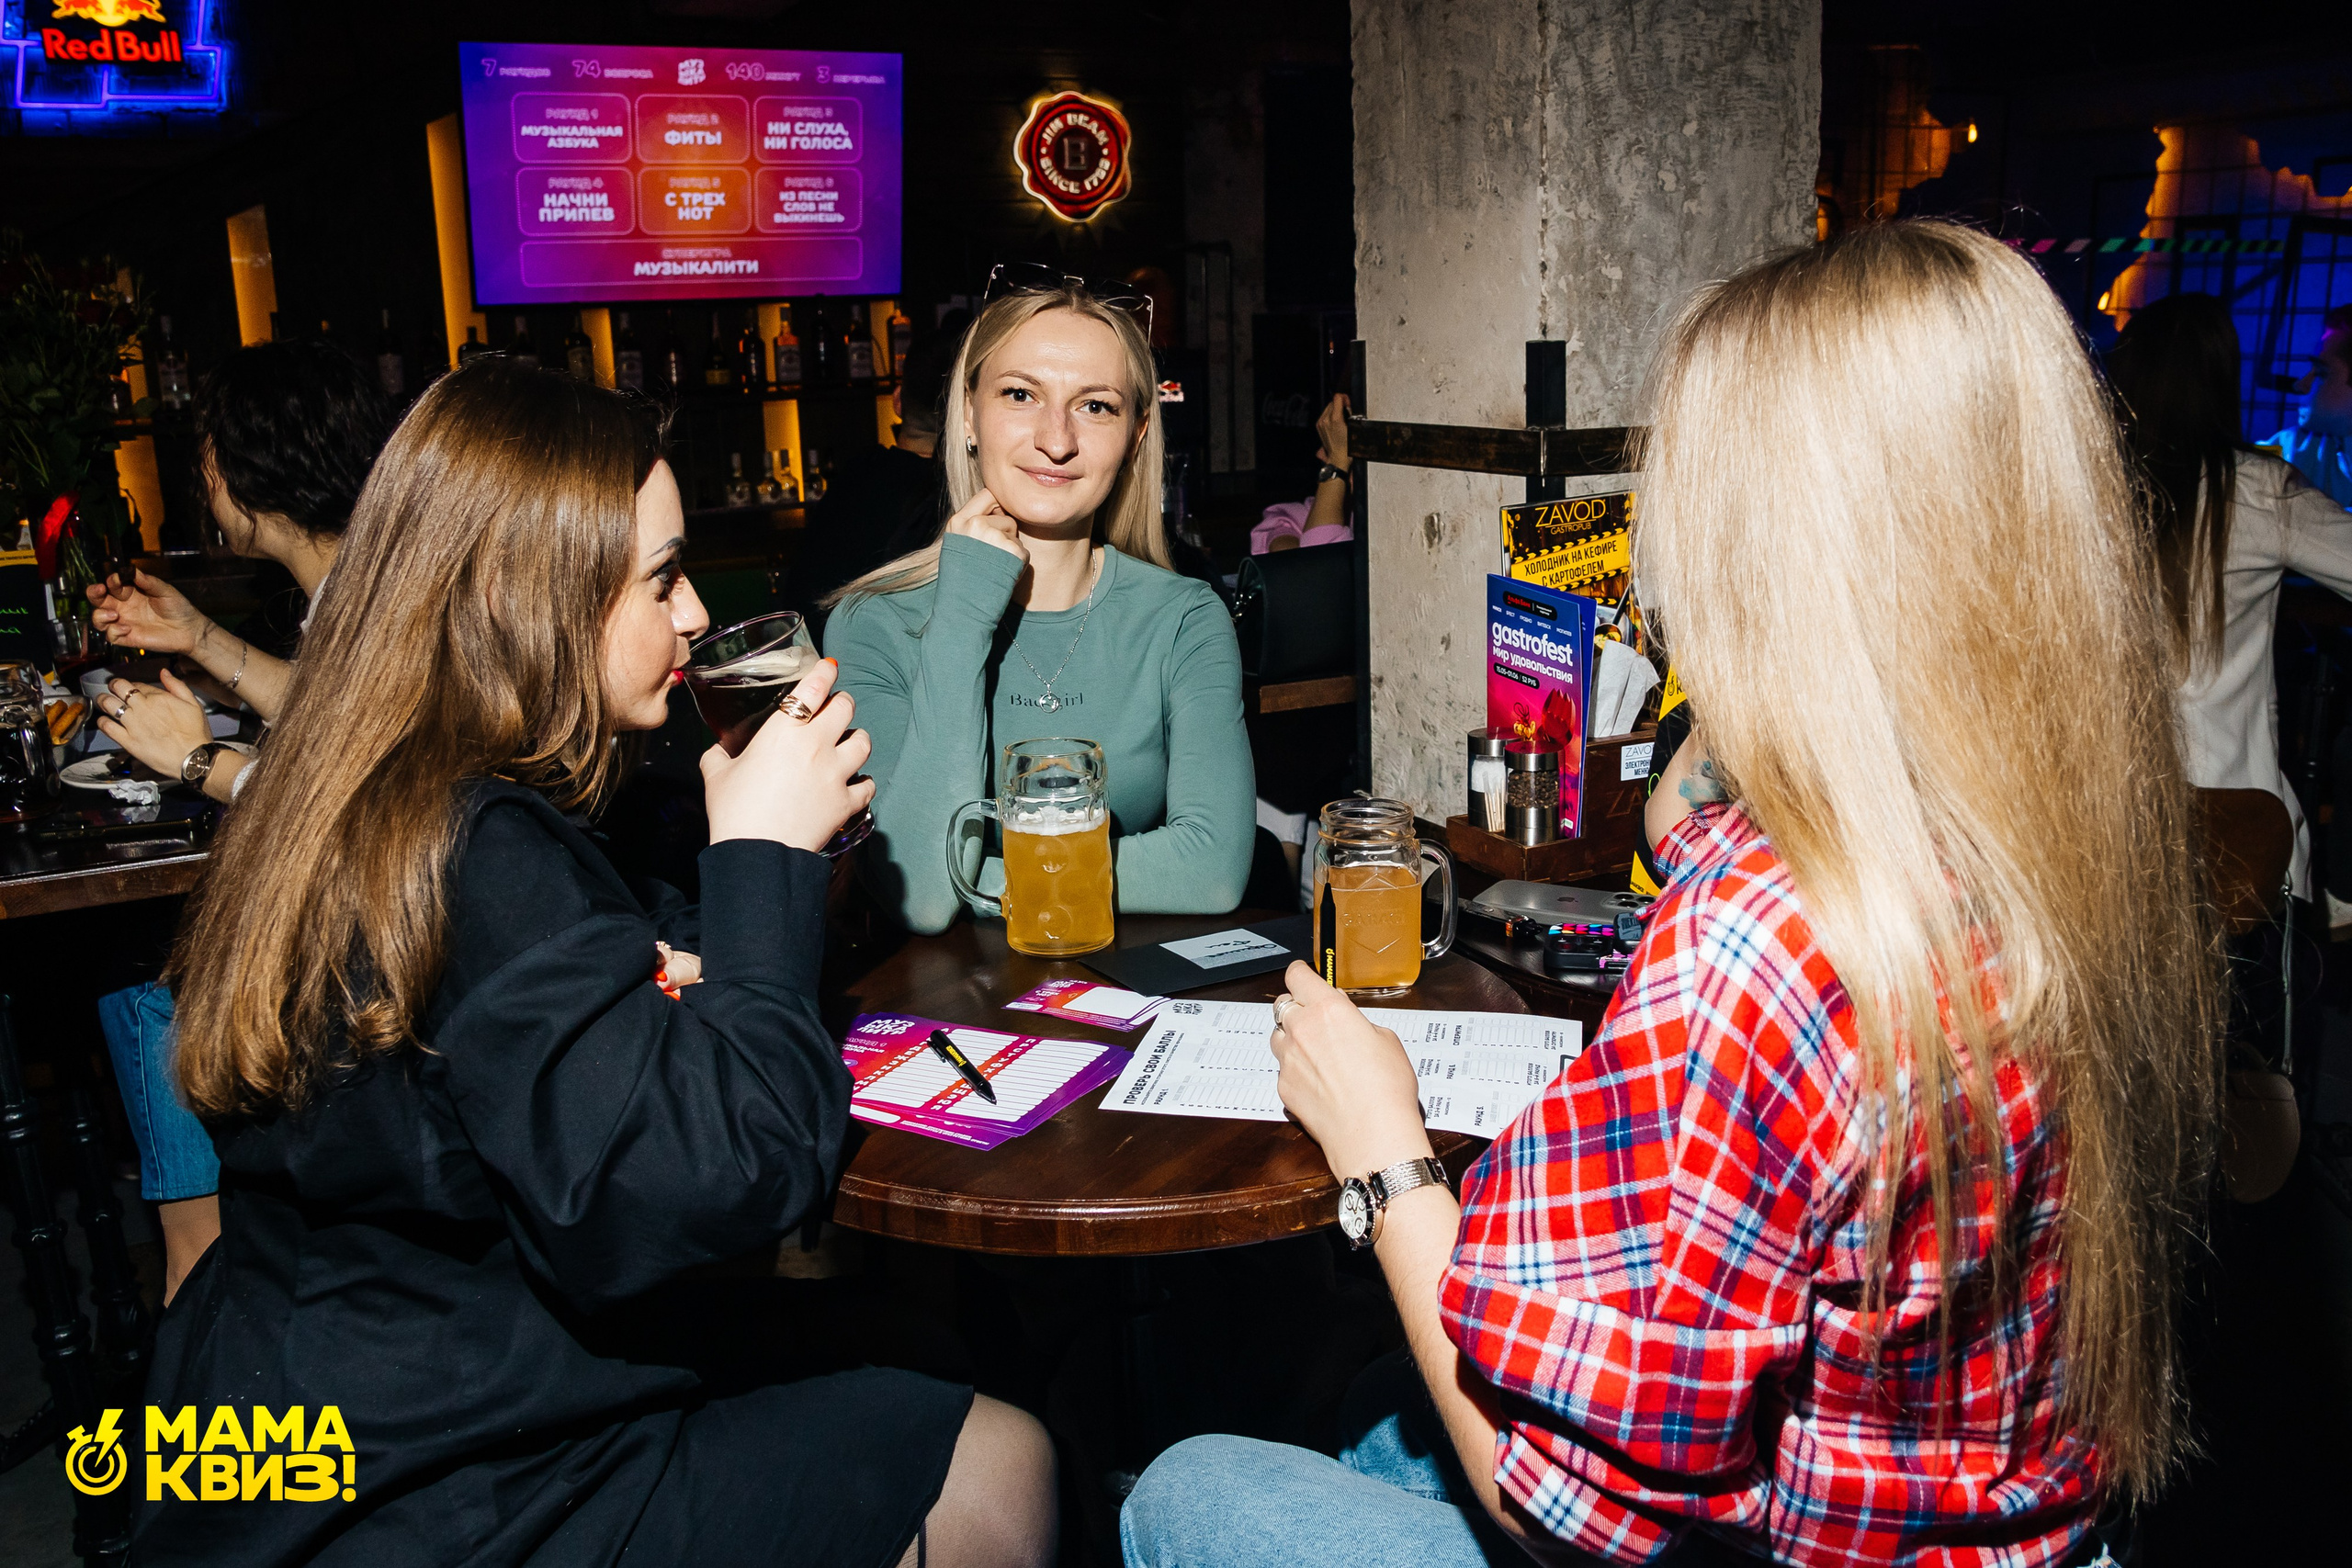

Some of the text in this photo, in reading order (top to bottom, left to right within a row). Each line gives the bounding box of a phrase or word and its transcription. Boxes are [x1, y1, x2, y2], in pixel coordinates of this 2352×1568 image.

[41, 28, 182, 62] Red Bull
[481, 58, 497, 76] 7
[571, 60, 601, 77] 74
[521, 125, 623, 137] МУЗЫКАЛЬНАЯ
[767, 122, 849, 137] НИ СЛУХА,
[1042, 113, 1110, 145] JIM BEAM
[547, 138, 599, 148] АЗБУКА
[664, 130, 722, 146] ФИТЫ
[763, 137, 853, 150] НИ ГОЛОСА
[1040, 156, 1080, 194] SINCE
[543, 193, 608, 207] НАЧНИ
[664, 192, 726, 206] С ТРЕХ
[779, 191, 838, 201] ИЗ ПЕСНИ
[678, 207, 714, 220] НОТ
[783, 202, 835, 211] СЛОВ НЕ
[538, 208, 615, 222] ПРИПЕВ
[774, 213, 845, 223] ВЫКИНЕШЬ
[634, 260, 759, 276] МУЗЫКАЛИТИ
[1535, 499, 1606, 527] ZAVOD
[1550, 522, 1592, 535] GASTROPUB
[1524, 540, 1618, 577] ХОЛОДНИК НА КЕФИРЕ
[1542, 559, 1605, 586] С КАРТОФЕЛЕМ
[1492, 622, 1573, 667] gastrofest
[1625, 745, 1652, 757] ZAVO
[1625, 760, 1650, 770] ЭЛЕКТРОН
[1123, 1073, 1151, 1105] ПРОВЕРЬ
[1143, 1053, 1163, 1073] СВОИ
[1154, 1030, 1177, 1054] БАЛЛЫ
[1154, 1091, 1168, 1105] РАУНД
[1475, 1111, 1484, 1126] РАУНД
